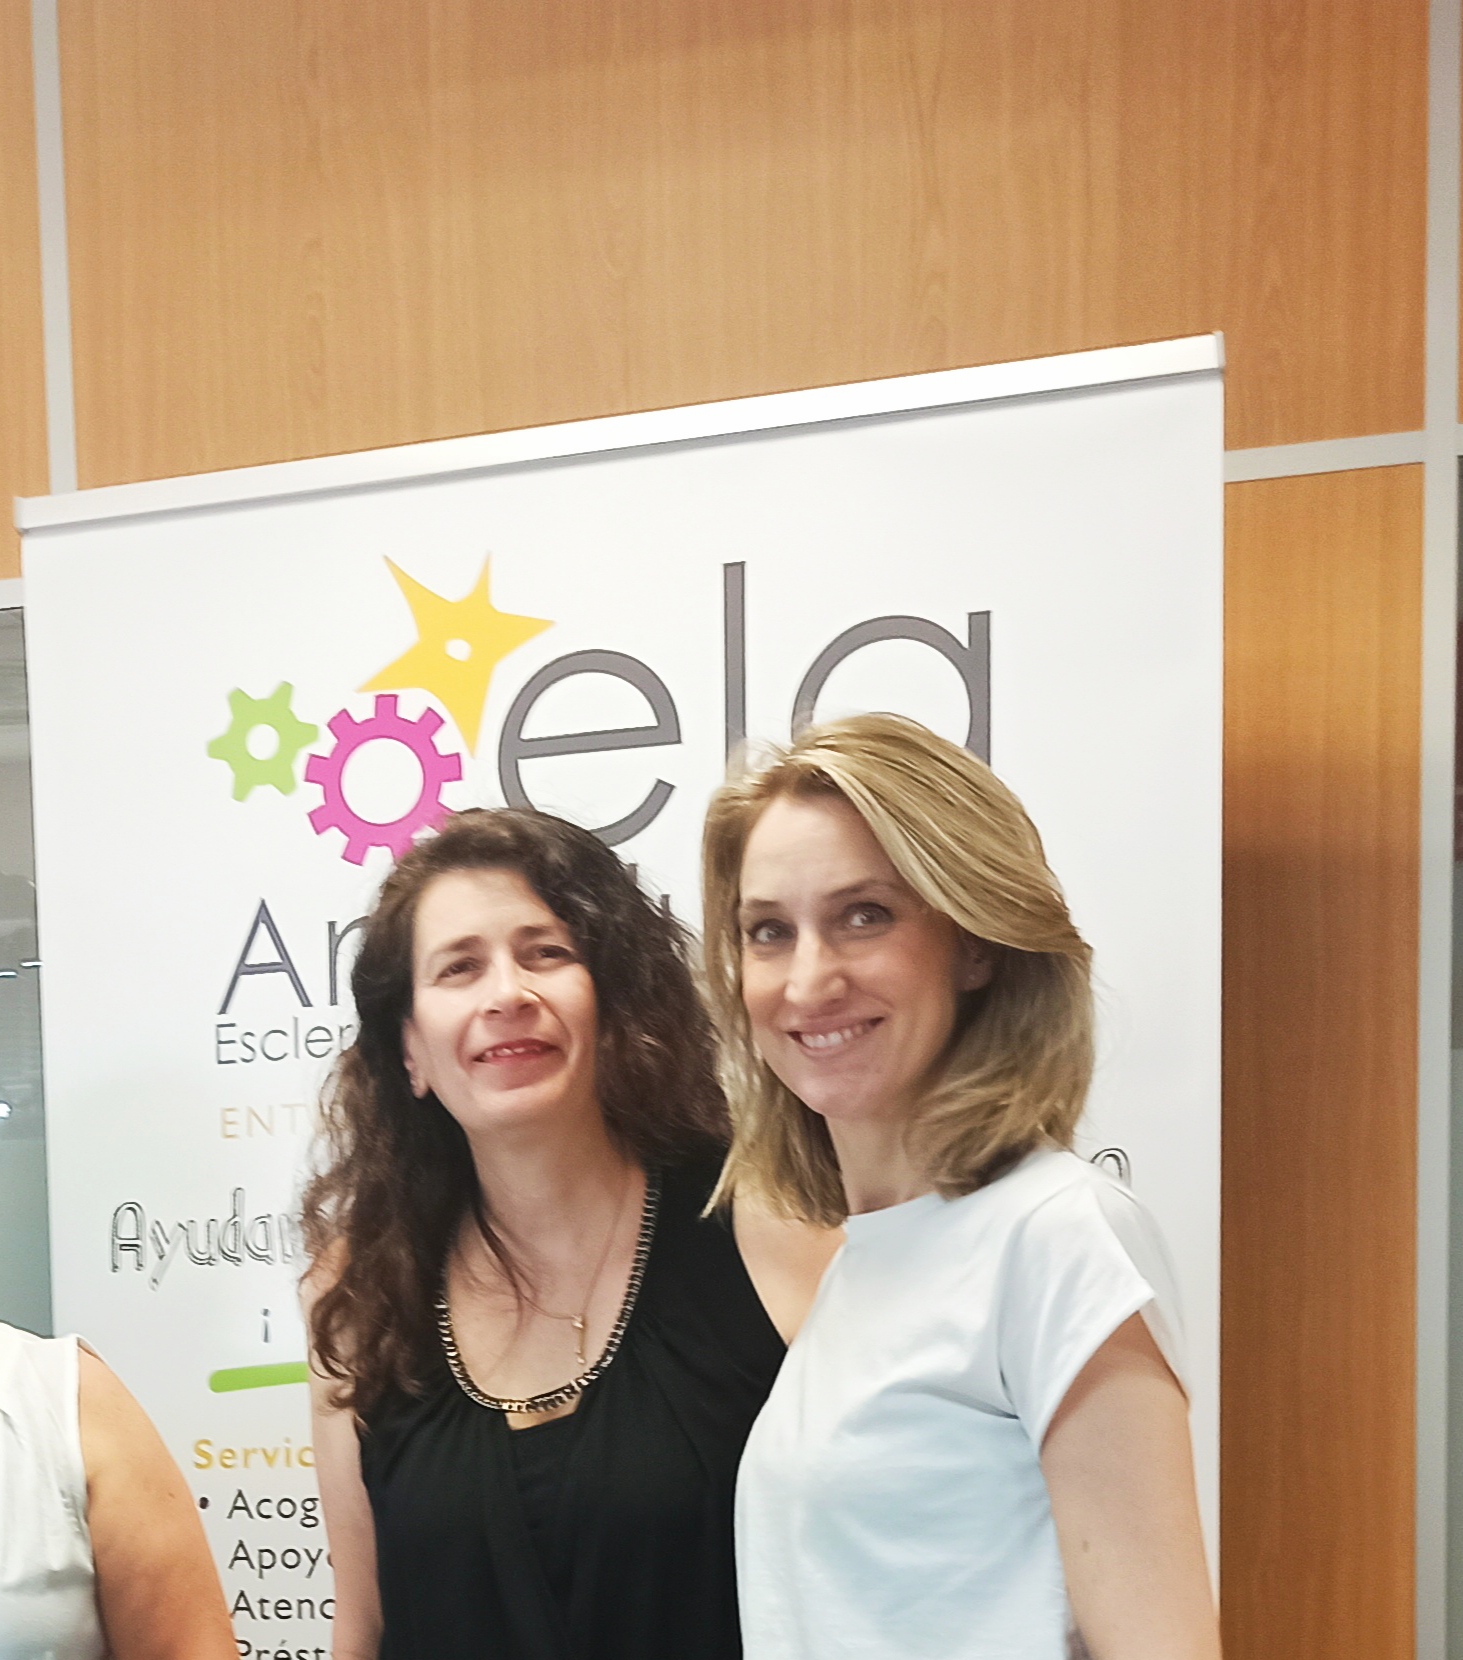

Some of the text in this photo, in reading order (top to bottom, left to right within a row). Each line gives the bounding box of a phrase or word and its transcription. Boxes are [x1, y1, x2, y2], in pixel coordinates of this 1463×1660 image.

[498, 560, 993, 846] ela
[226, 1488, 320, 1529] Acog
[228, 1539, 334, 1580] Apoy
